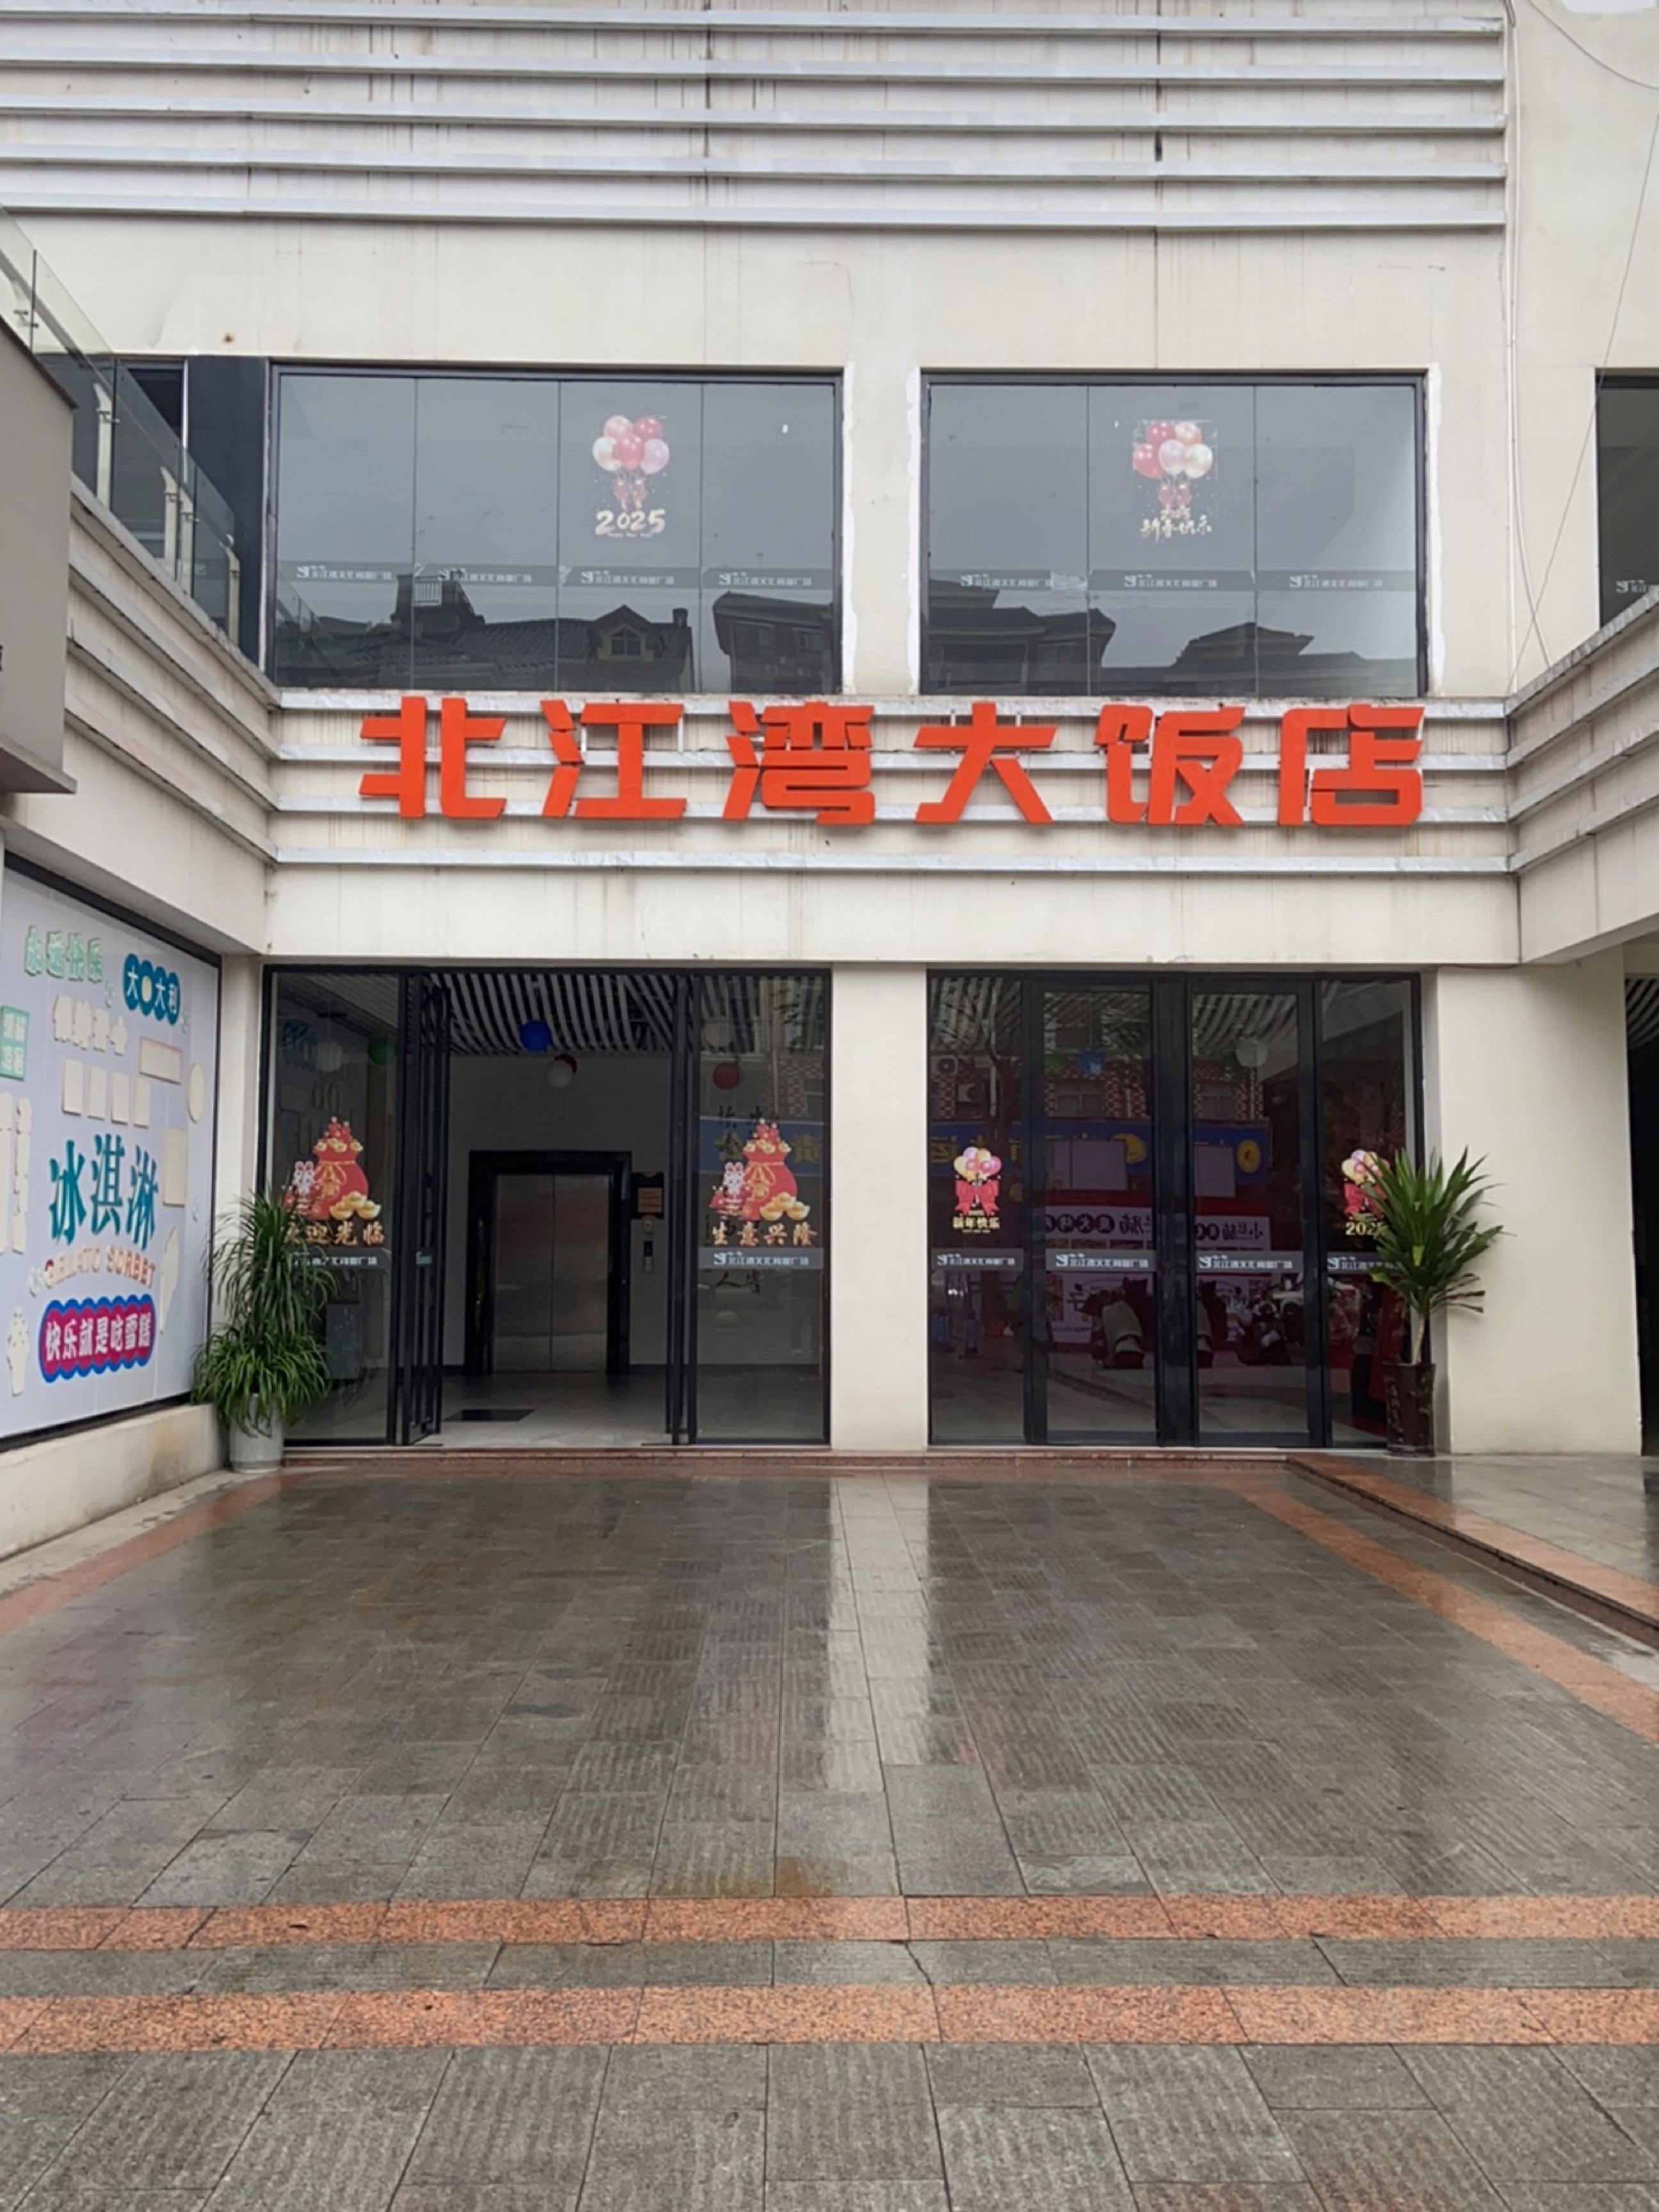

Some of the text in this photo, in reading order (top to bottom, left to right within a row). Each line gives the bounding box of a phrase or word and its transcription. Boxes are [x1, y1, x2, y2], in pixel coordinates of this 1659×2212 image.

[595, 508, 666, 534] 2025
[360, 696, 1425, 826] 北江湾大饭店
[49, 1132, 159, 1251] 冰淇淋
[712, 1220, 819, 1247] 生意兴隆
